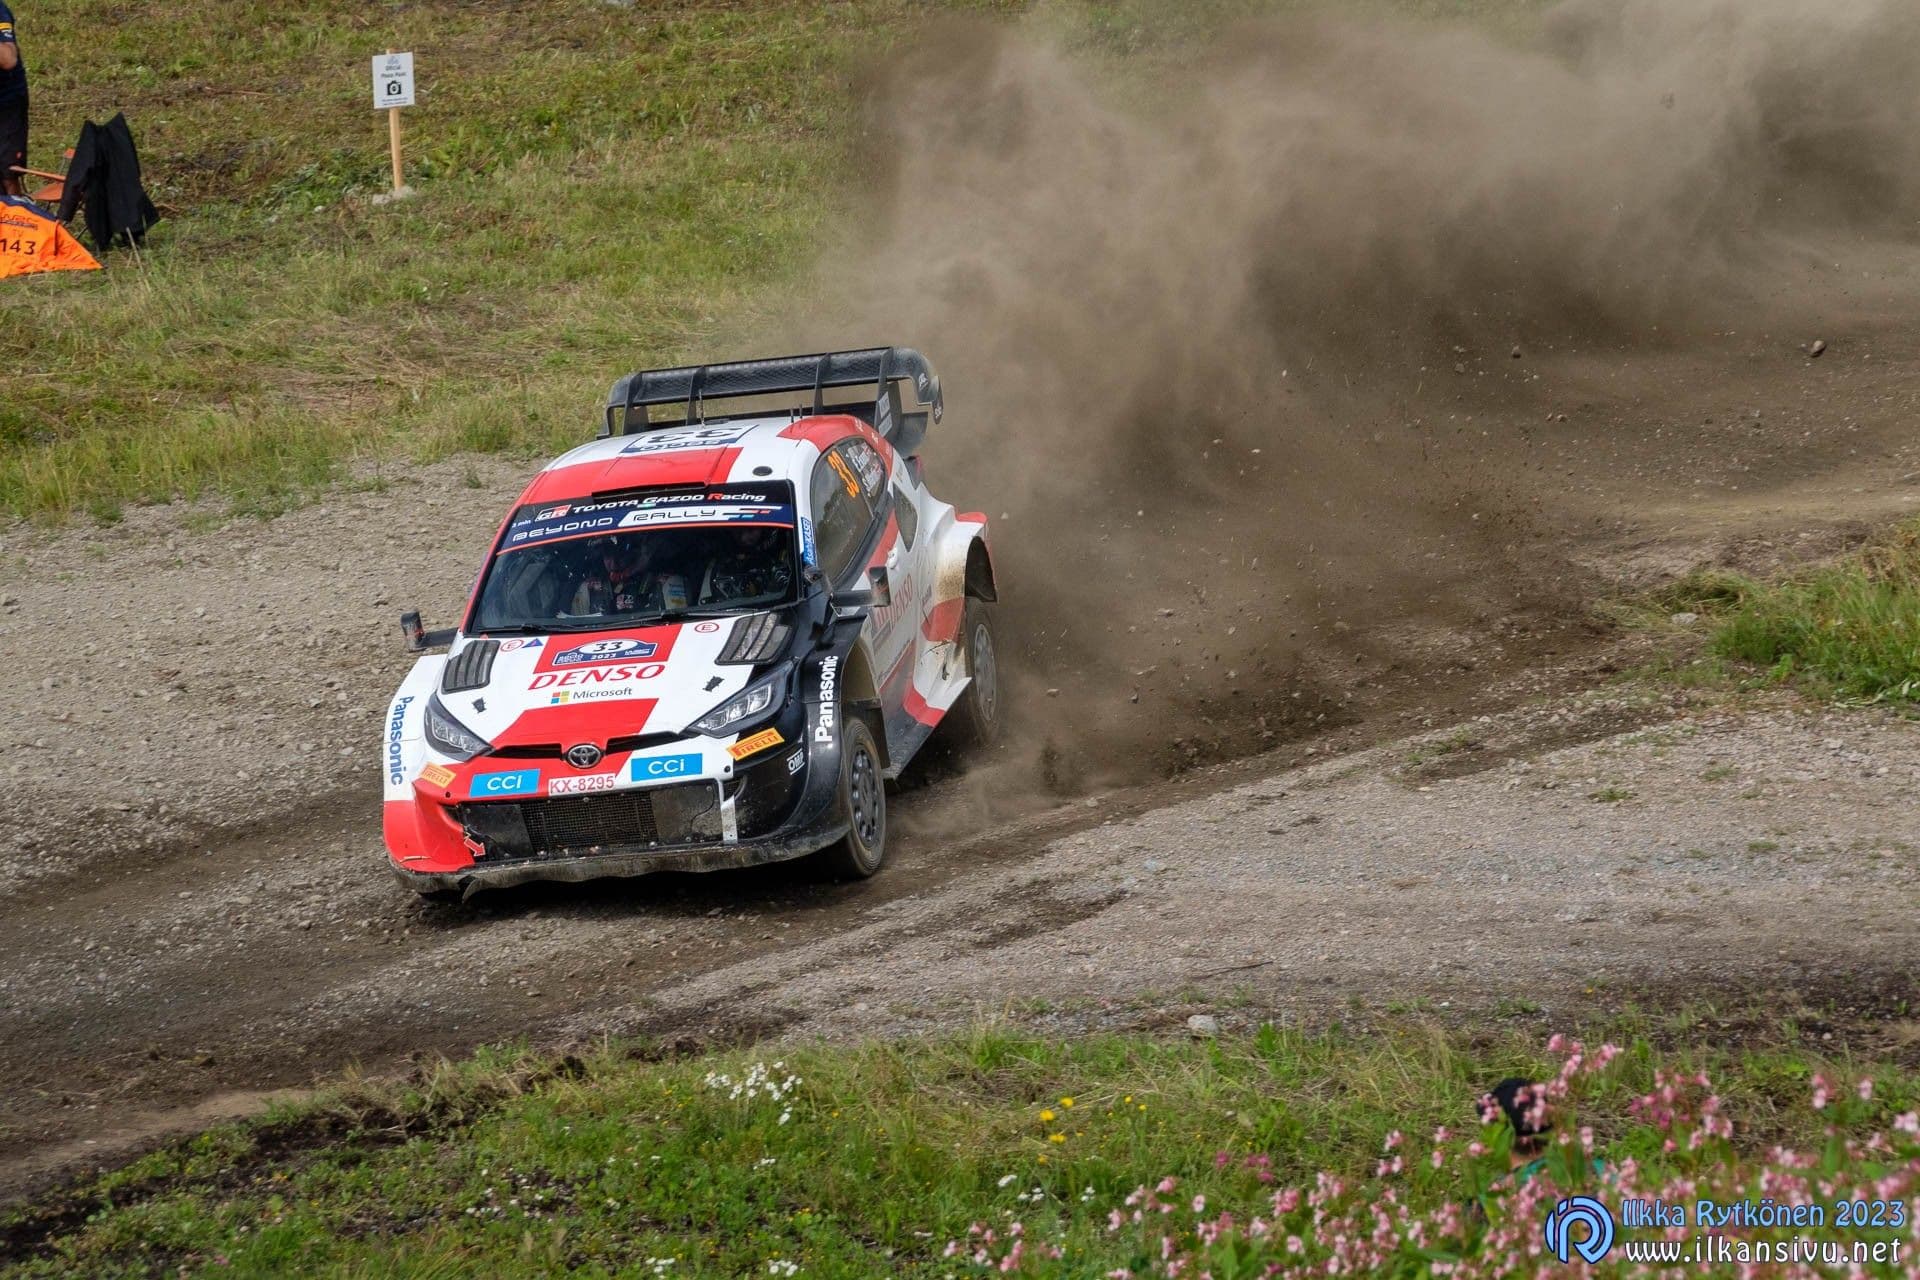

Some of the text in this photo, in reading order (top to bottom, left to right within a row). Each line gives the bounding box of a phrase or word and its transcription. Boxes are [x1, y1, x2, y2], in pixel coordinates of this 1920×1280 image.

[573, 500, 638, 514] TOYOTA
[641, 493, 705, 504] GAZOO
[706, 493, 766, 502] Racing
[512, 509, 717, 542] BEYOND RALLY
[593, 641, 624, 652] 33
[527, 664, 666, 691] DENSO
[572, 687, 633, 699] Microsoft
[814, 655, 839, 743] Panasonic
[389, 695, 416, 786] Panasonic
[648, 758, 685, 775] CCI
[788, 751, 804, 771] OMP
[487, 774, 523, 791] CCI
[550, 776, 614, 793] KX-8295
